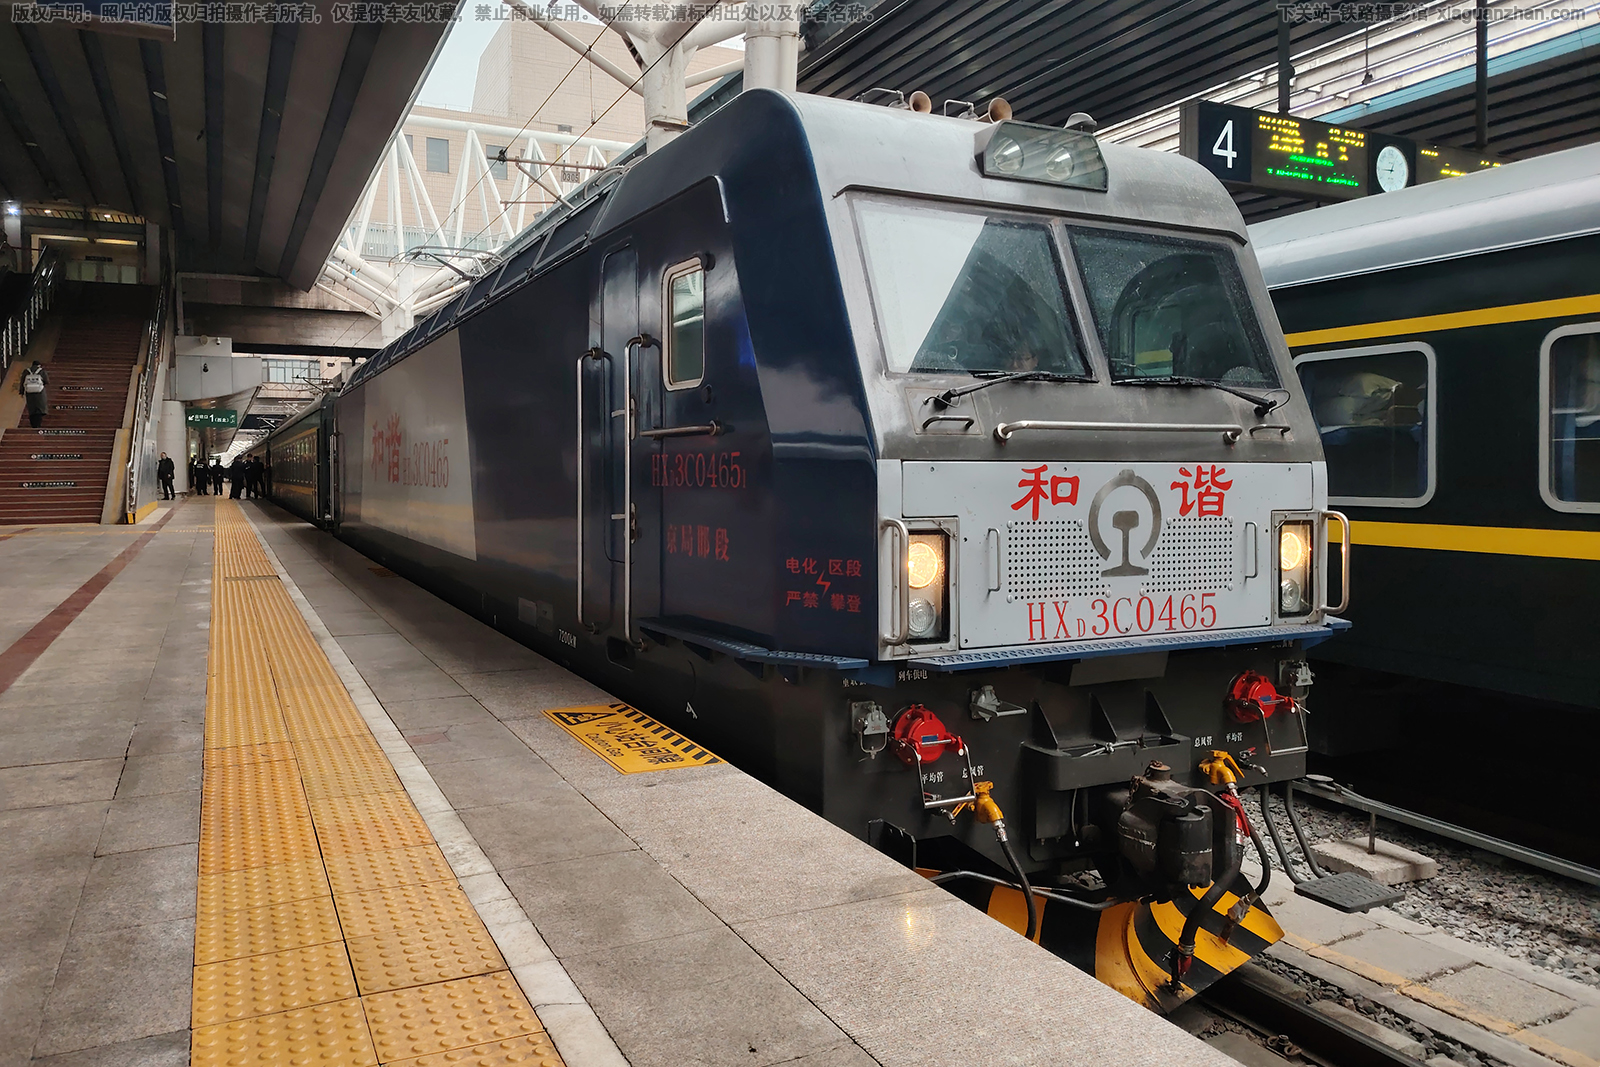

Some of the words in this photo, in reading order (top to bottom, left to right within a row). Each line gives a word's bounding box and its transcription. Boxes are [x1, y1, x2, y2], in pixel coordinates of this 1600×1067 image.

[1212, 119, 1238, 169] 4
[1010, 464, 1080, 521] 和
[1170, 464, 1233, 518] 谐
[786, 557, 818, 576] 电化
[828, 559, 862, 577] 区段
[786, 590, 819, 609] 严禁
[830, 593, 861, 613] 攀登
[1027, 592, 1217, 642] HXD3C0465
